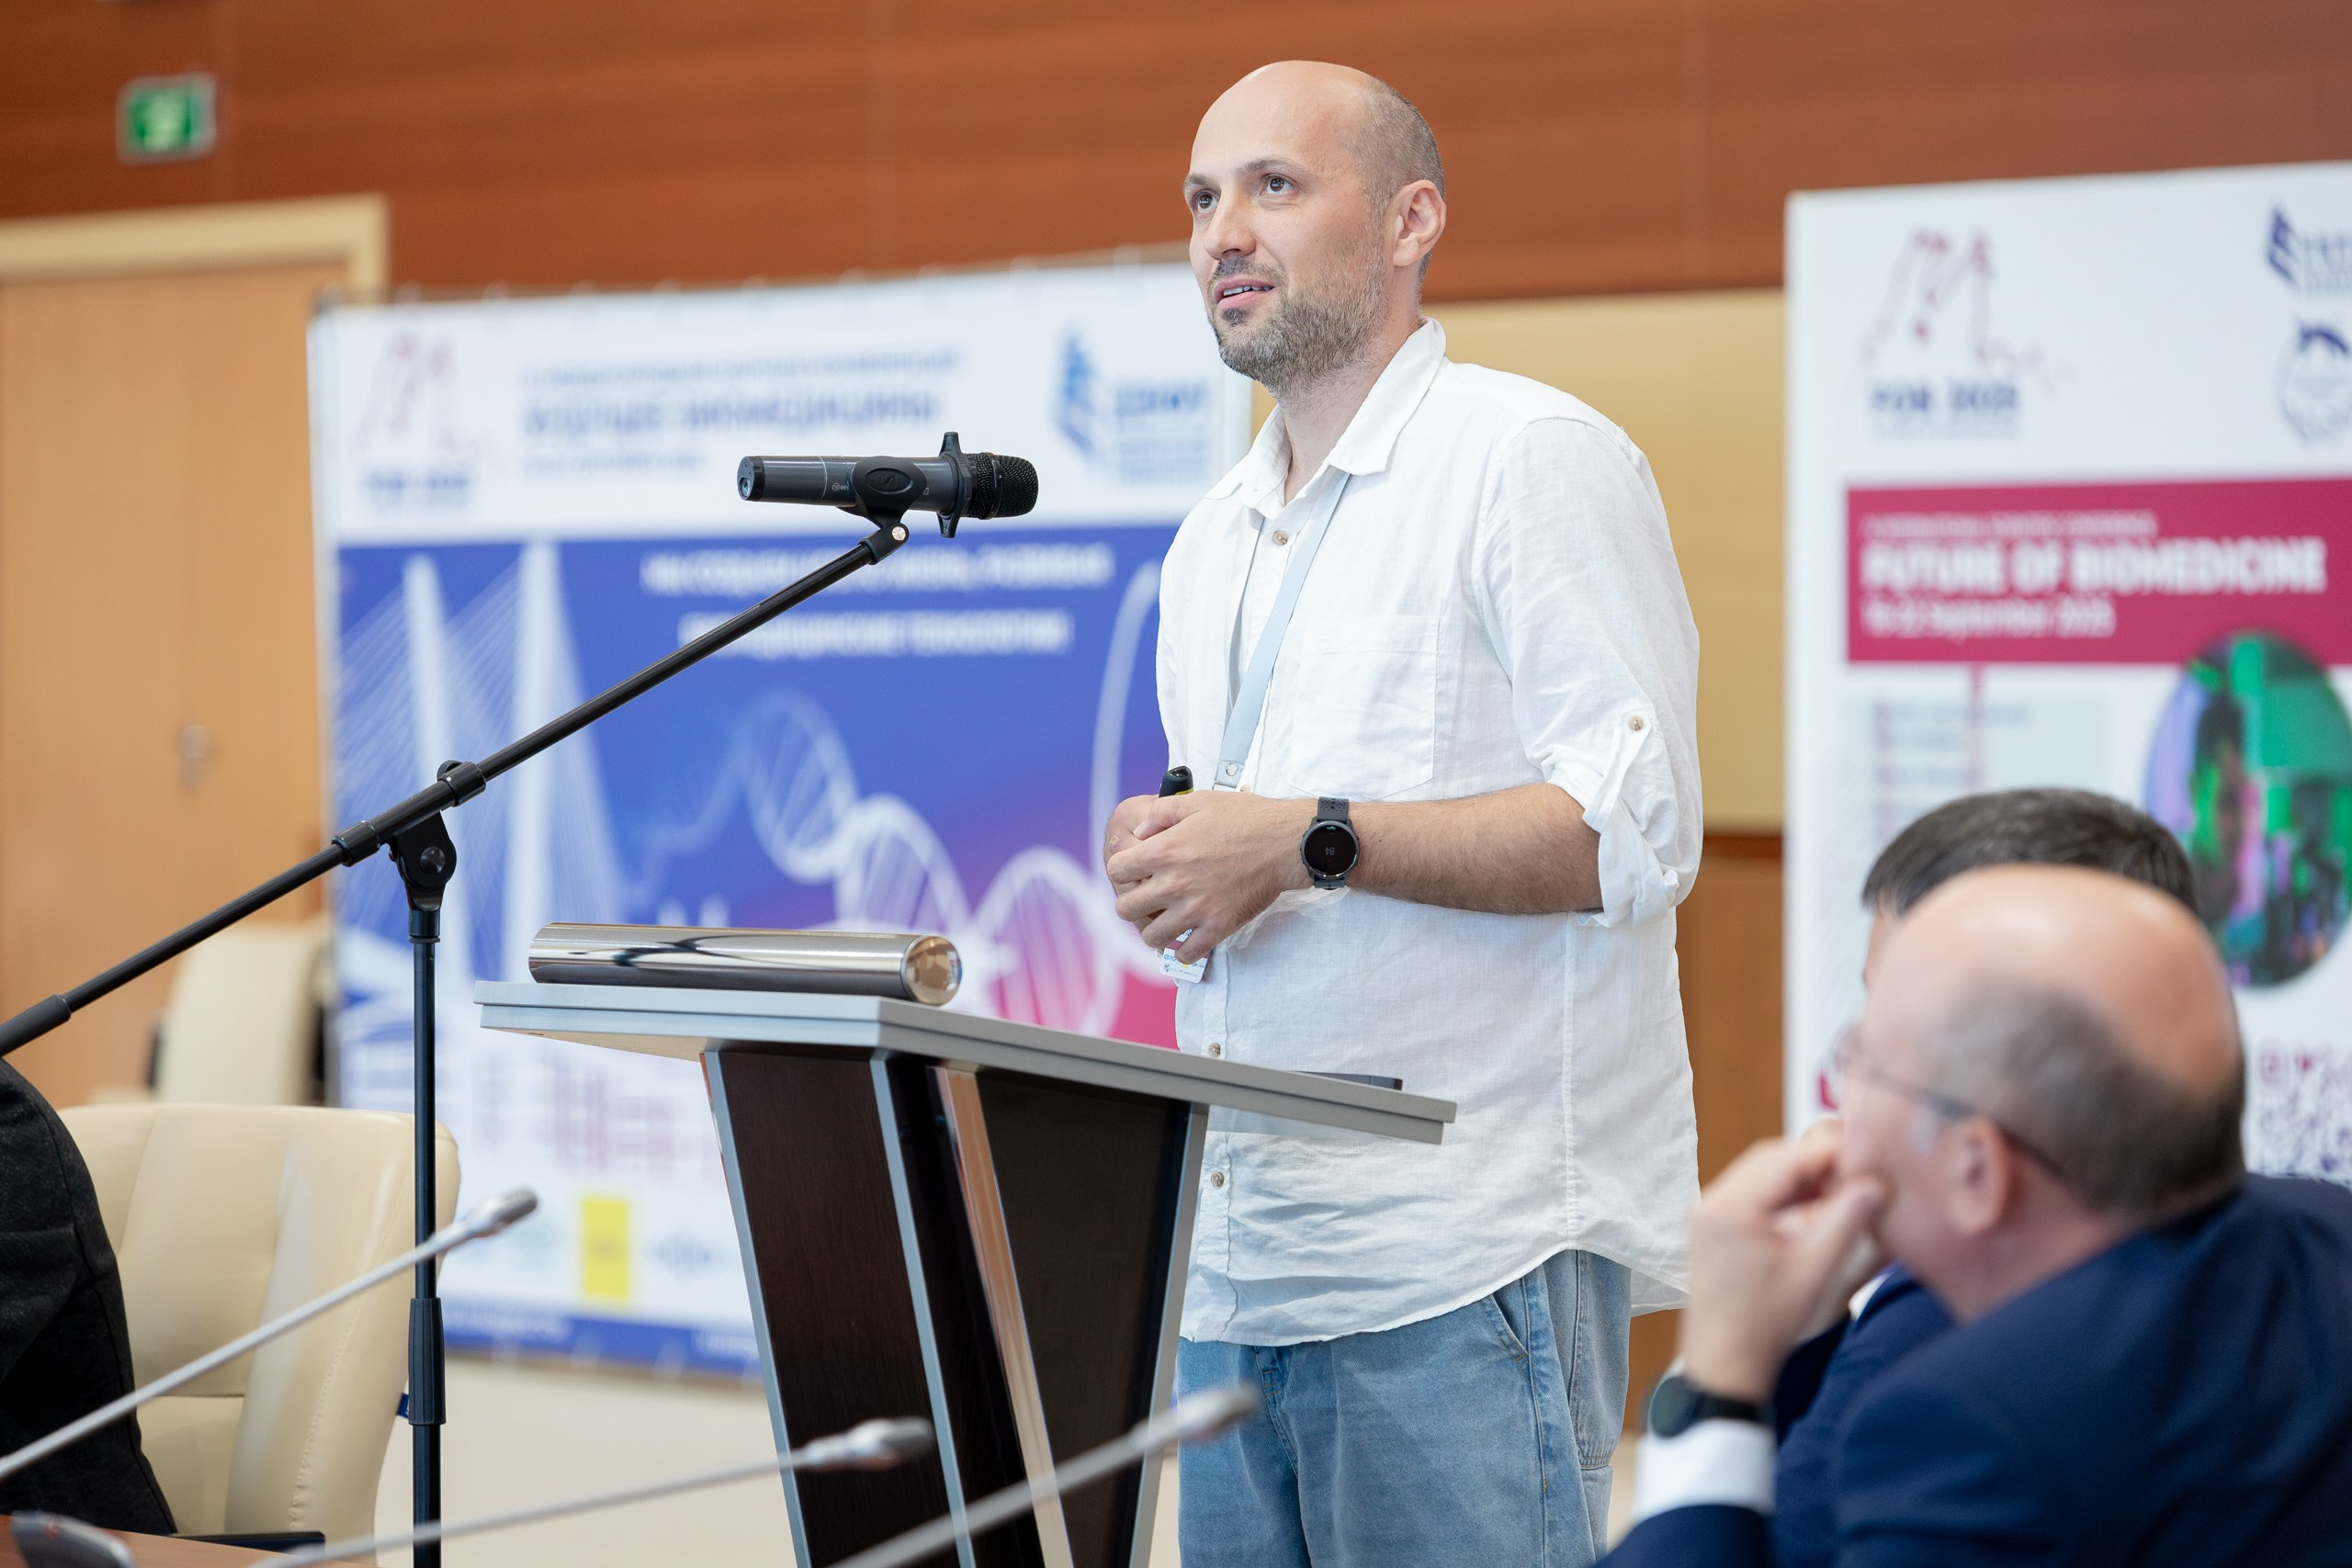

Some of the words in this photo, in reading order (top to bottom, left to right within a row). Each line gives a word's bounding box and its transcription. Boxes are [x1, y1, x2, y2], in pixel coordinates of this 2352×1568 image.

[1863, 540, 2004, 592] FUTURE
[2012, 539, 2063, 592] OF
[2071, 537, 2324, 592] BIOMEDICINE
